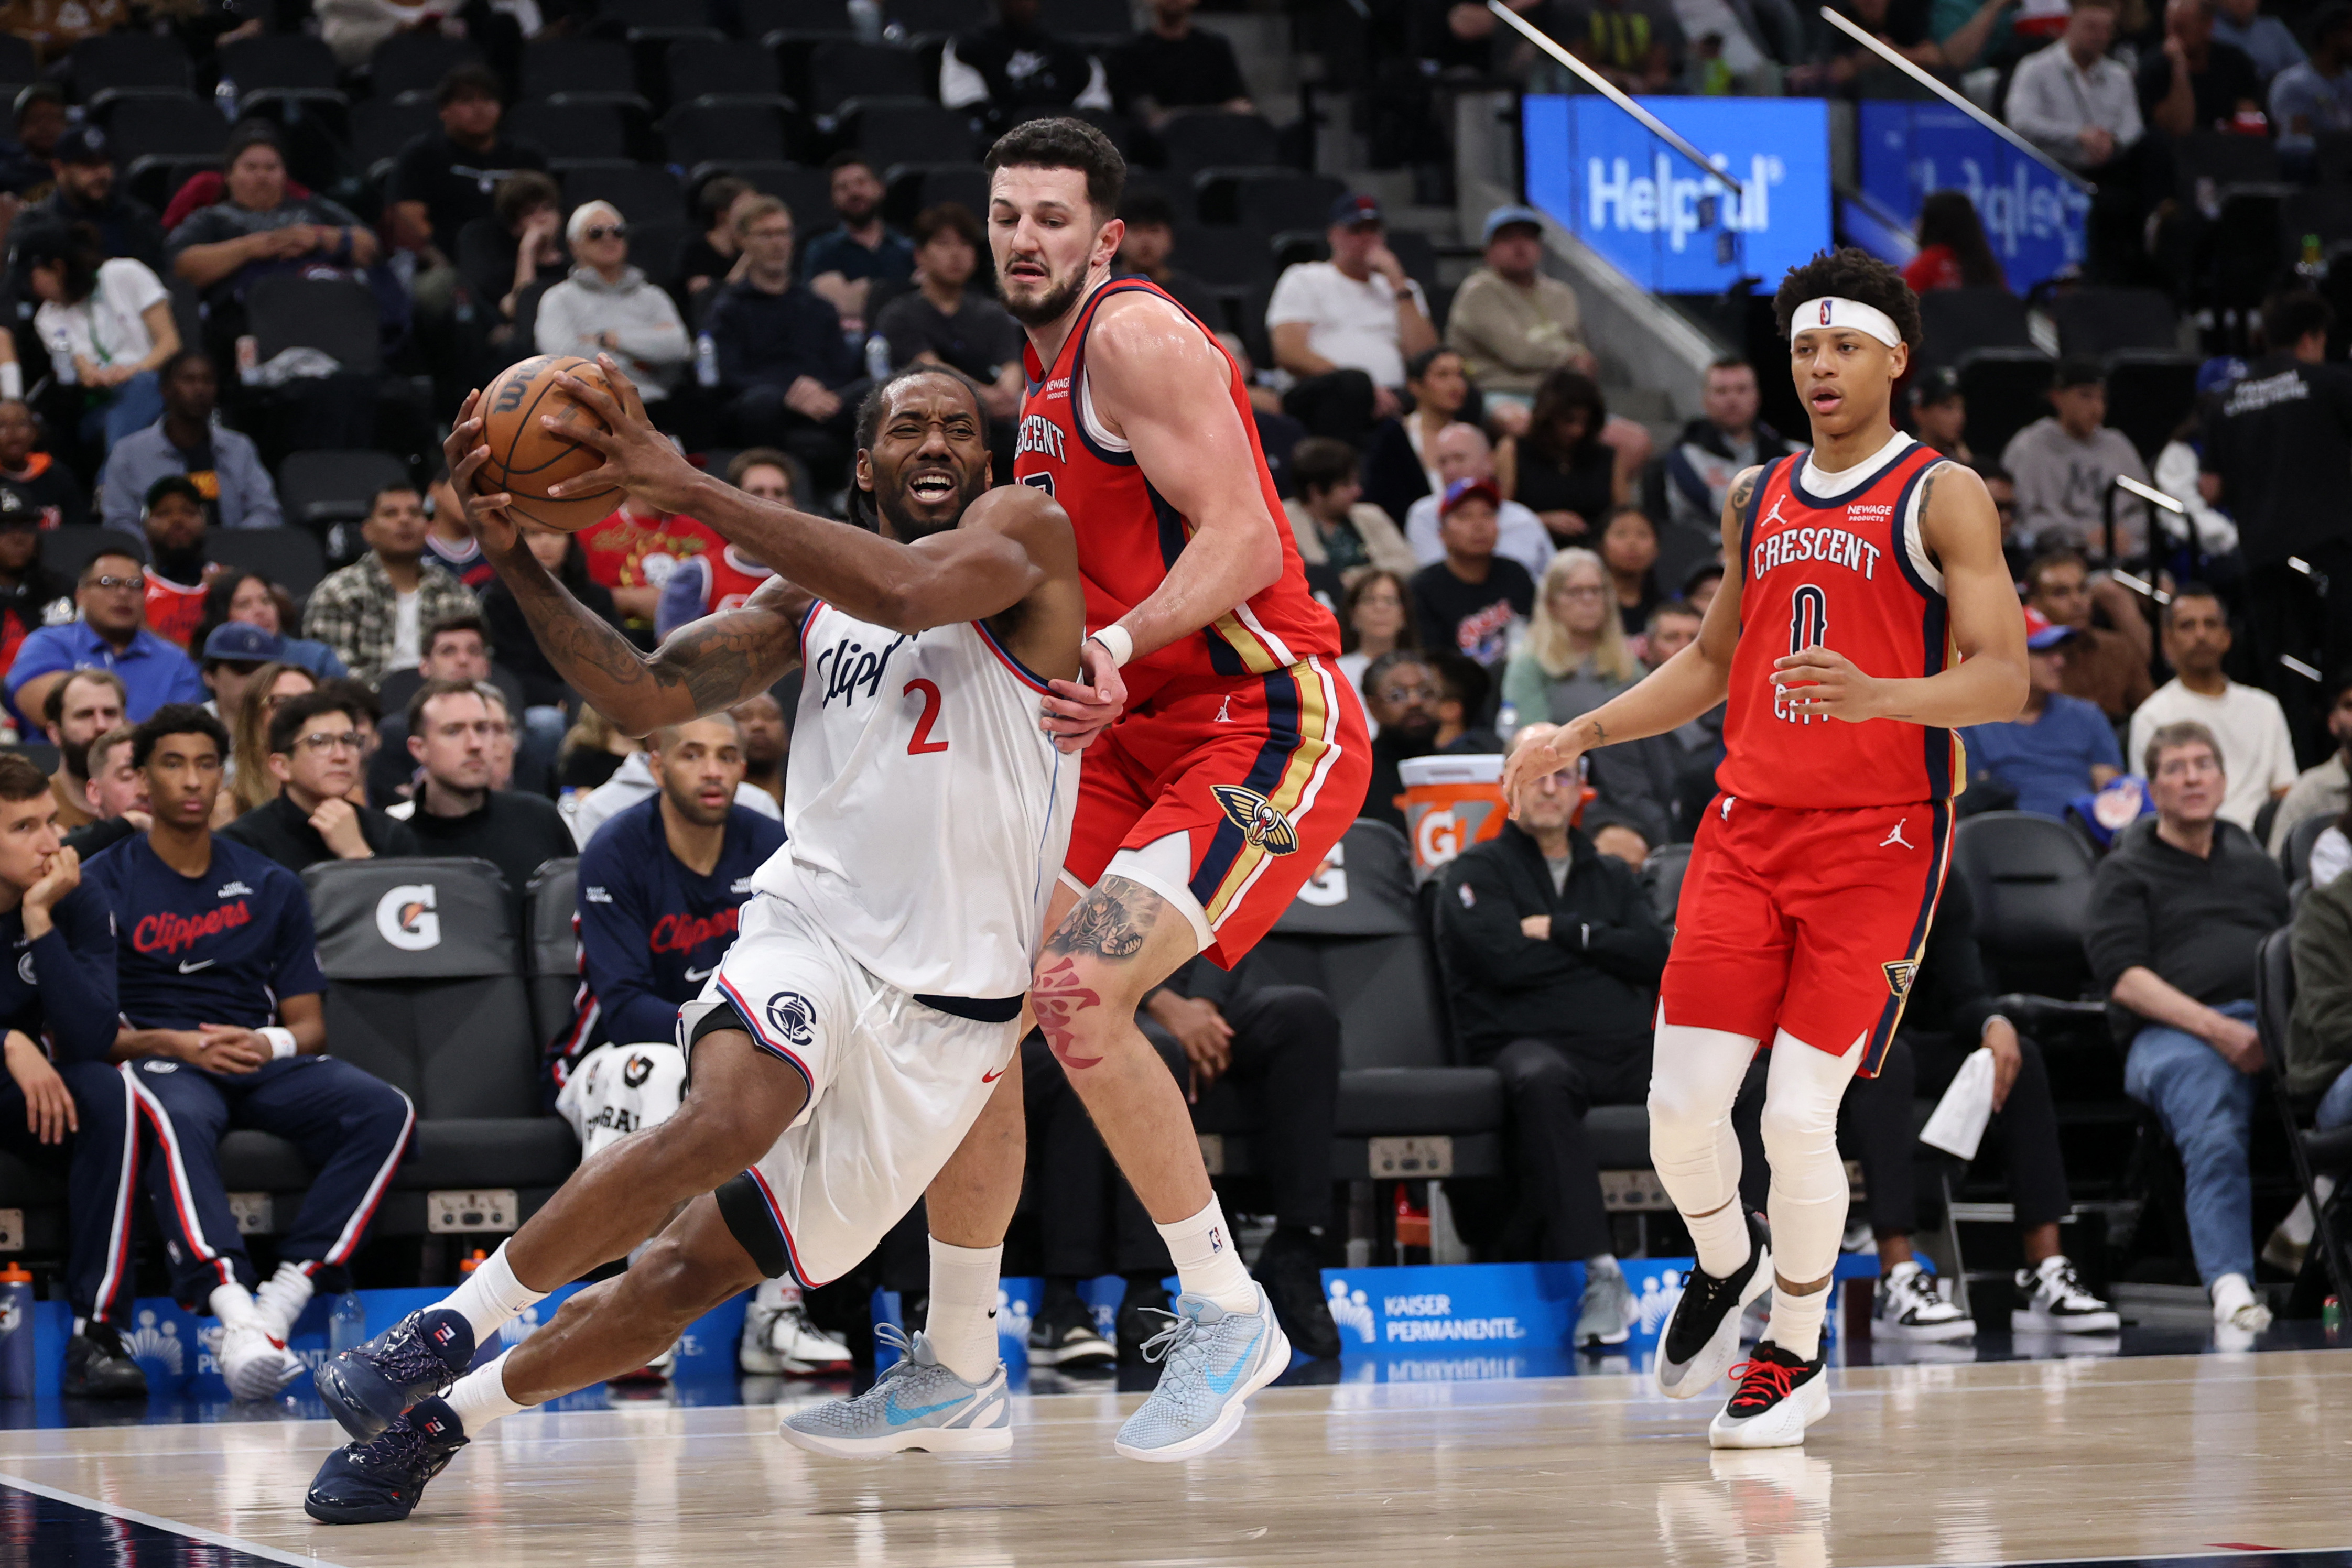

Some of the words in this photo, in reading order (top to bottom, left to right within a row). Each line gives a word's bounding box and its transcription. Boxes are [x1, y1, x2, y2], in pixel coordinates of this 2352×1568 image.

[1047, 390, 1068, 400] PRODUCTS
[1847, 504, 1893, 515] NEWAGE
[1754, 527, 1881, 581] CRESCENT
[903, 678, 949, 755] 2
[1418, 810, 1458, 867] G
[133, 900, 252, 954] Clippers
[375, 884, 441, 951] G
[1384, 1294, 1451, 1316] KAISER
[1386, 1317, 1518, 1342] PERMANENTE
